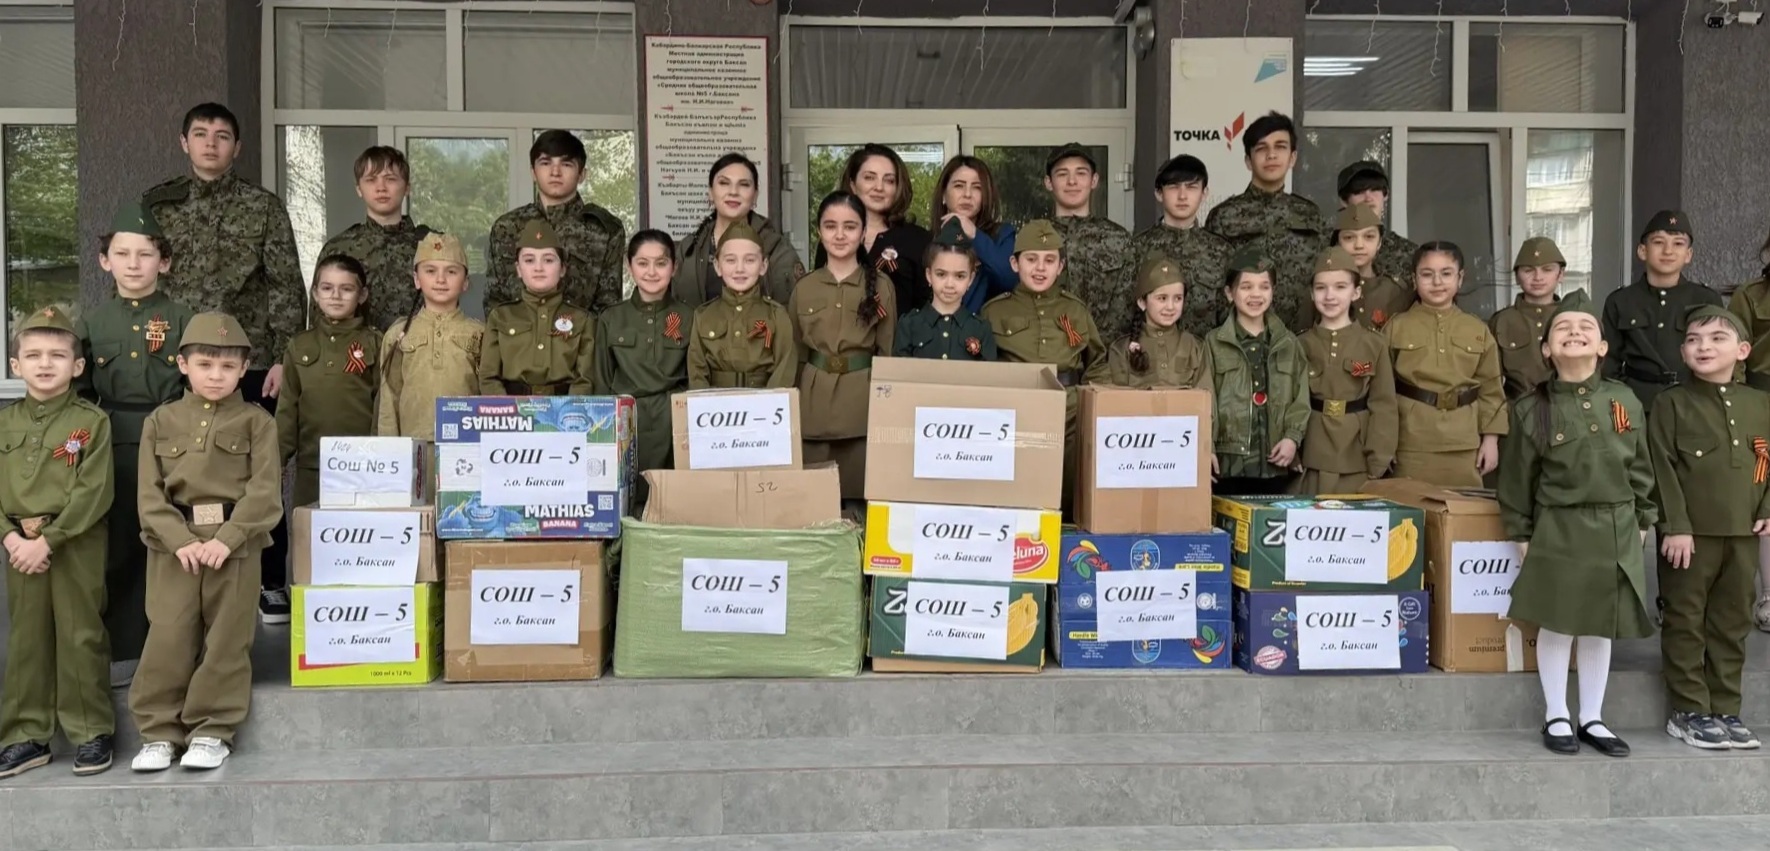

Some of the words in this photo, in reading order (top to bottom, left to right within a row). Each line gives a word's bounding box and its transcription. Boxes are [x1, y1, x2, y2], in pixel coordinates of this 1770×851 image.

[1174, 130, 1221, 141] ТОЧКА
[479, 406, 515, 414] BANANA
[462, 415, 533, 432] MATHIAS
[696, 410, 748, 428] СОШ
[772, 407, 784, 426] 5
[922, 422, 974, 440] СОШ
[997, 423, 1010, 441] 5
[710, 442, 728, 450] г.о.
[731, 438, 770, 449] Баксан
[1104, 432, 1157, 449] СОШ
[1179, 430, 1192, 448] 5
[489, 448, 544, 465] СОШ
[568, 446, 581, 465] 5
[935, 453, 952, 461] г.о.
[955, 451, 993, 462] Баксан
[327, 456, 361, 472] Сош
[366, 459, 386, 474] №
[390, 460, 399, 475] 5
[1118, 463, 1135, 471] г.о.
[1138, 460, 1176, 470] Баксан
[503, 479, 521, 487] г.о.
[525, 476, 565, 487] Баксан
[524, 504, 595, 518] MATHIAS
[542, 520, 578, 528] BANANA
[319, 527, 375, 544] СОШ
[400, 526, 414, 545] 5
[921, 522, 974, 540] СОШ
[996, 524, 1010, 542] 5
[1294, 525, 1347, 542] СОШ
[1370, 525, 1383, 544] 5
[334, 558, 352, 566] г.о.
[355, 556, 396, 567] Баксан
[934, 553, 951, 561] г.о.
[954, 551, 993, 563] Баксан
[1307, 555, 1324, 564] г.о.
[1327, 553, 1366, 565] Баксан
[1458, 558, 1510, 575] СОШ
[691, 574, 745, 592] СОШ
[768, 574, 781, 594] 5
[480, 586, 536, 603] СОШ
[560, 584, 574, 603] 5
[1104, 585, 1156, 603] СОШ
[1178, 582, 1191, 601] 5
[1473, 589, 1490, 597] г.о.
[313, 605, 370, 623] СОШ
[395, 602, 409, 622] 5
[704, 605, 721, 614] г.о.
[724, 603, 764, 615] Баксан
[914, 598, 967, 617] СОШ
[990, 600, 1003, 619] 5
[493, 617, 512, 625] г.о.
[515, 614, 556, 625] Баксан
[1137, 612, 1175, 623] Баксан
[1305, 611, 1357, 629] СОШ
[1380, 609, 1393, 628] 5
[328, 637, 346, 645] г.о.
[350, 634, 391, 645] Баксан
[927, 629, 944, 638] г.о.
[947, 627, 986, 640] Баксан
[1340, 640, 1378, 650] Баксан
[1468, 645, 1506, 653] premium
